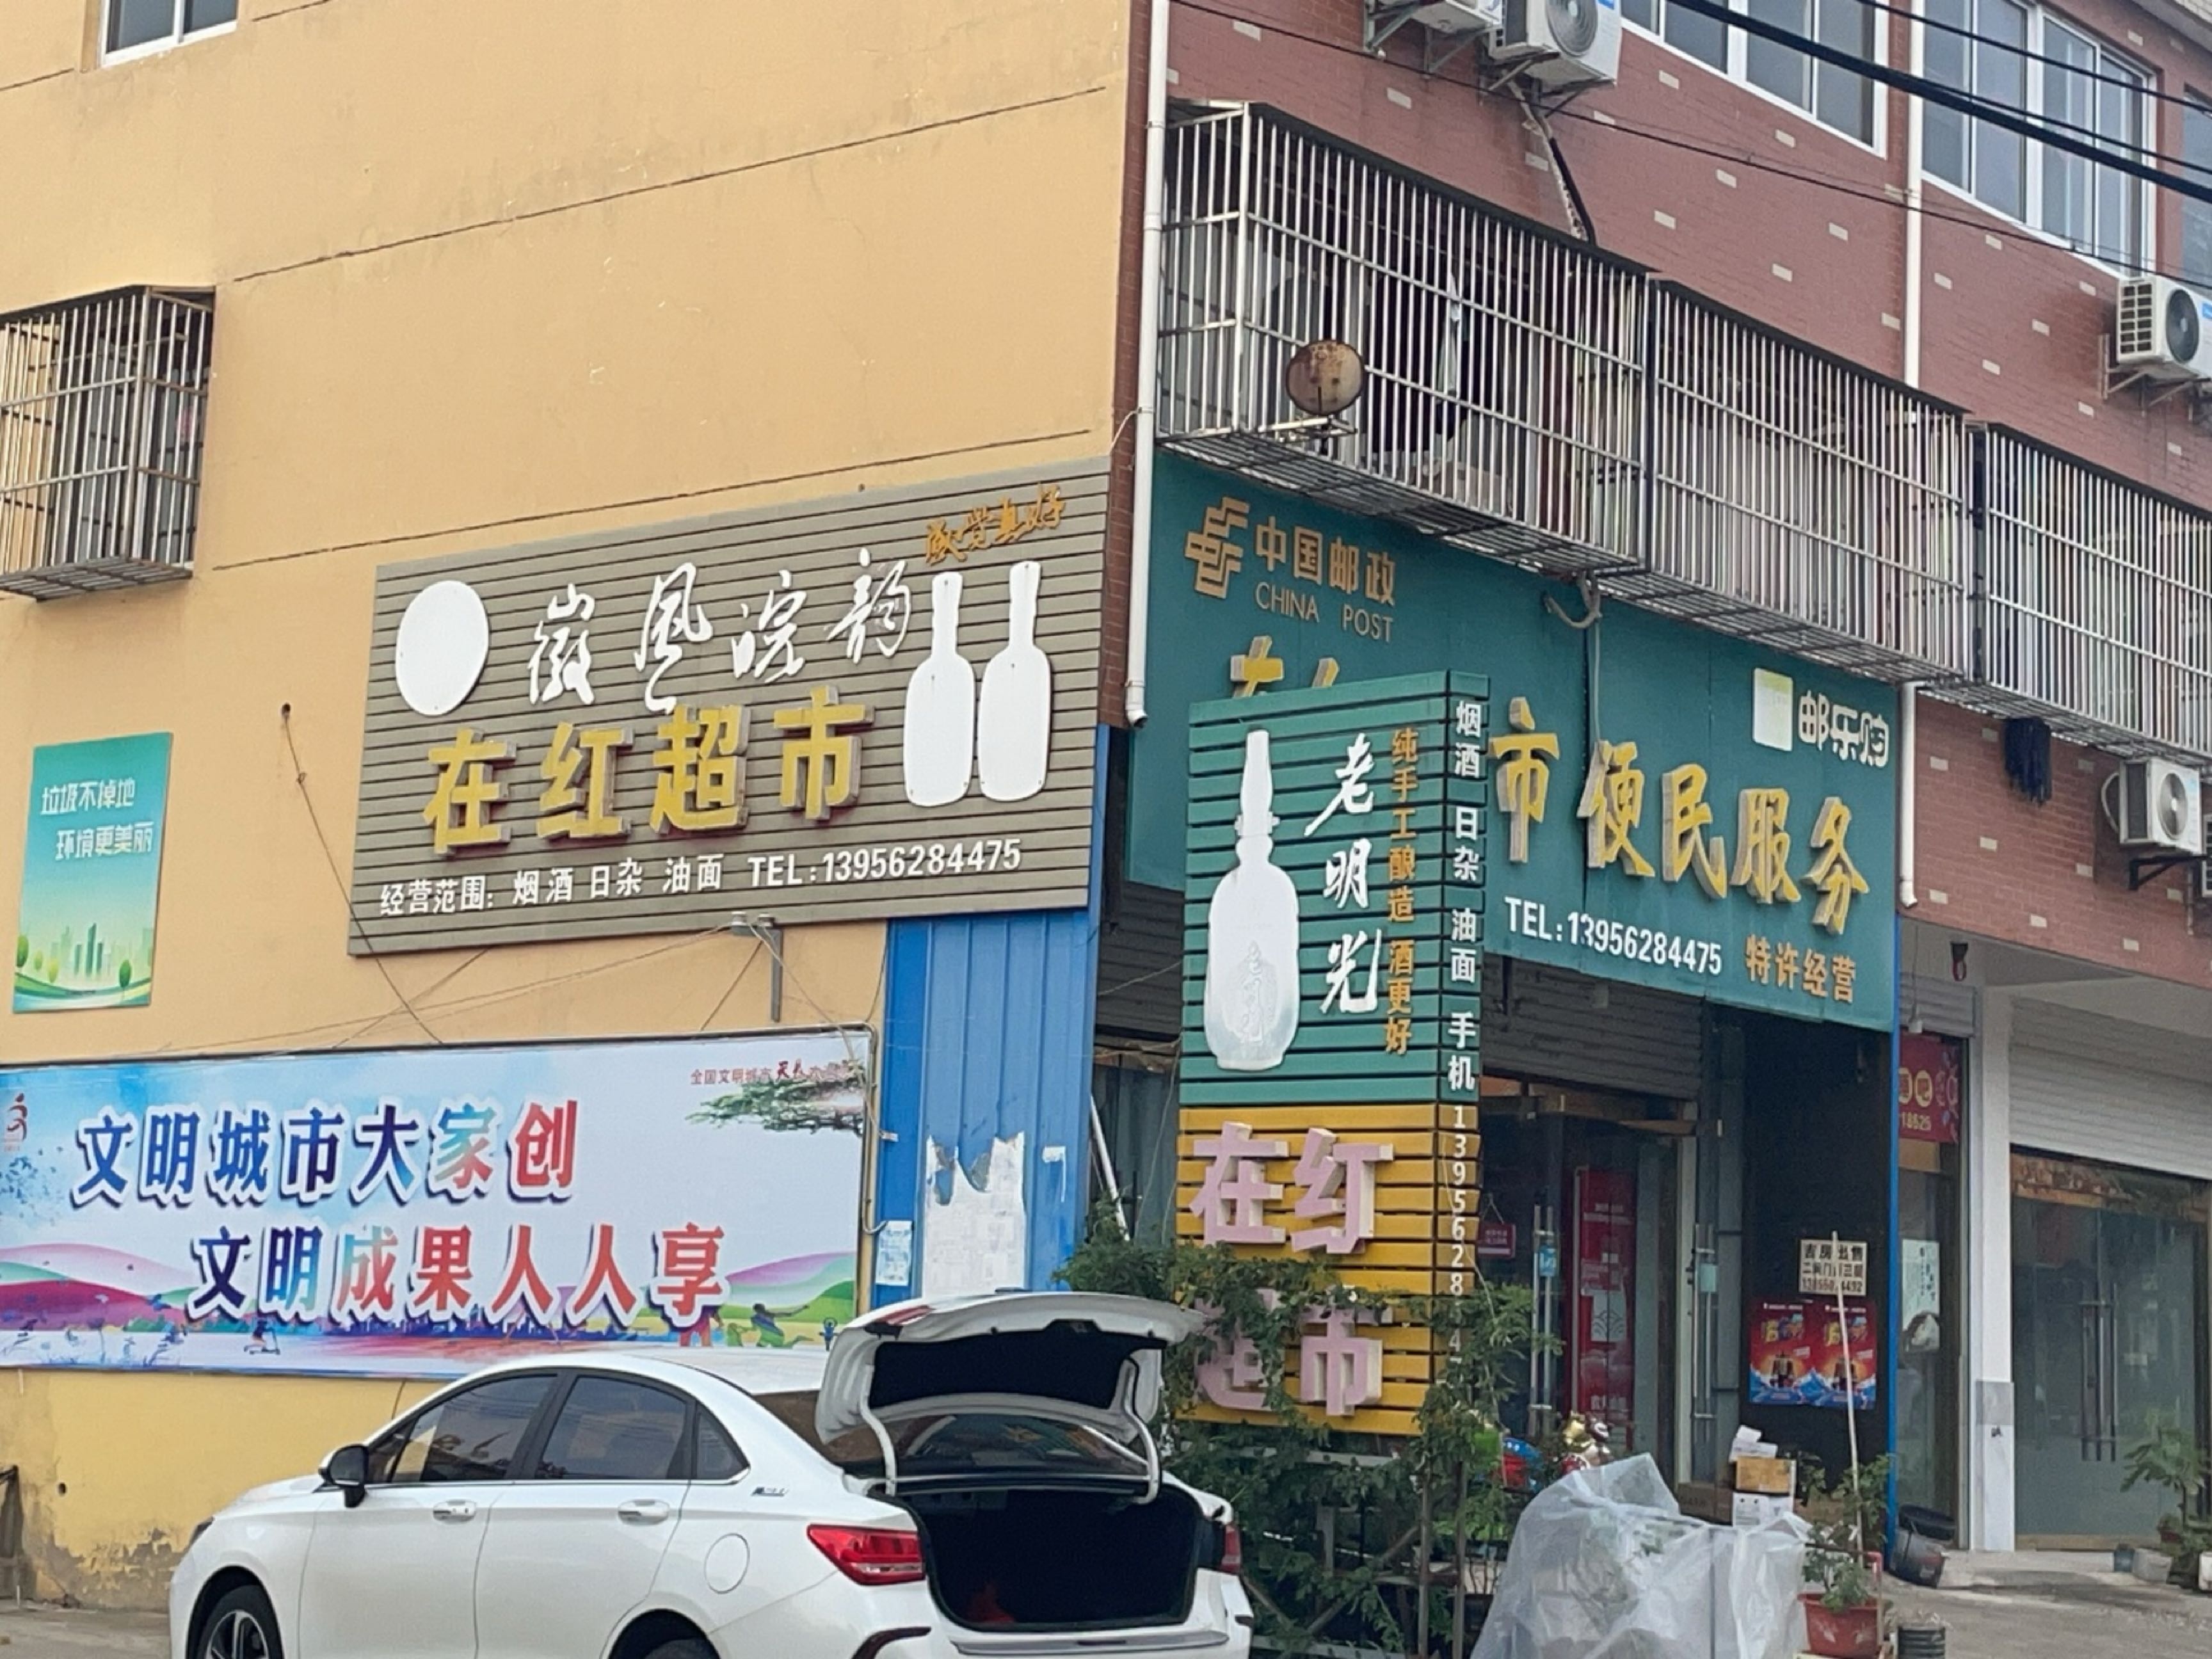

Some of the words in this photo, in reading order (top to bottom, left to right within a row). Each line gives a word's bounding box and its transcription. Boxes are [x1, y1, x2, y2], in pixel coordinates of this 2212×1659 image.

[1254, 515, 1397, 607] 中国邮政
[529, 548, 914, 714] 徽风皖韵
[1254, 581, 1320, 623] CHINA
[1342, 604, 1394, 643] POST
[1454, 701, 1482, 779] 烟酒
[1797, 690, 1890, 767] 邮乐购
[40, 777, 136, 815] 垃圾不掉地
[422, 685, 874, 856] 在红超市
[55, 821, 154, 860] 环境更美丽
[1304, 733, 1382, 1014] 老明光
[1453, 806, 1480, 882] 日杂
[1450, 908, 1477, 983] 油面
[1504, 897, 1722, 975] TEL:13956284475
[1745, 934, 1856, 1004] 特许经营
[76, 1099, 579, 1199] 文明城市大家创
[1189, 1121, 1394, 1254] 在红
[189, 1222, 725, 1318] 文明成果人人享
